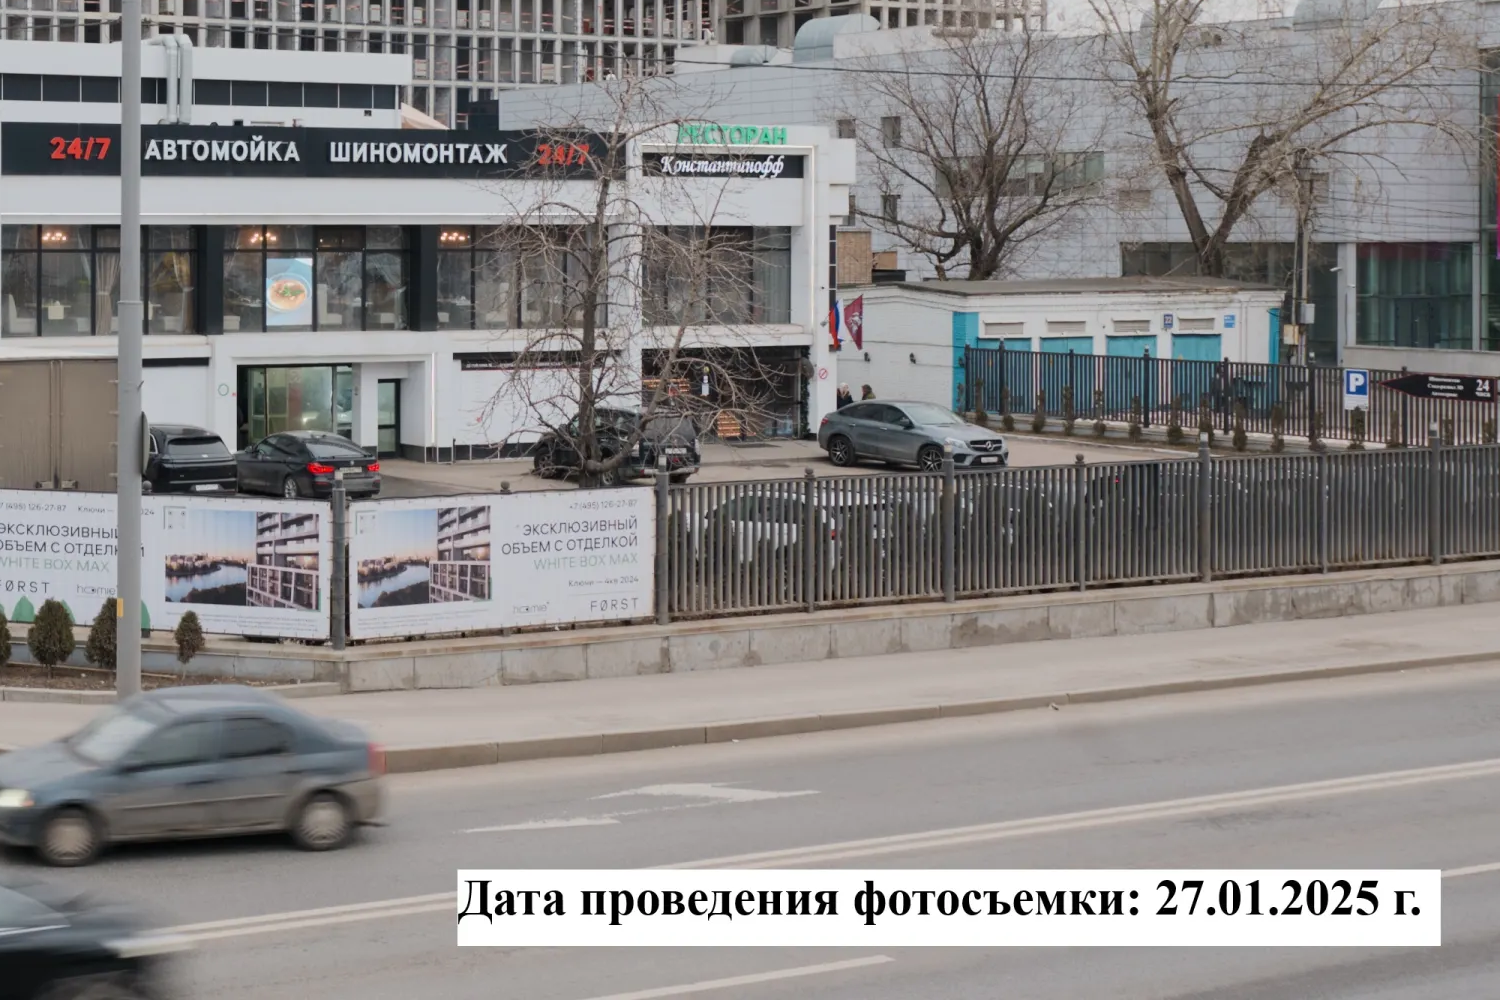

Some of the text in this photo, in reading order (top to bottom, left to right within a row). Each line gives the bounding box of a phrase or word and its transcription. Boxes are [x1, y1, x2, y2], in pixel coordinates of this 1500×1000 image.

[678, 124, 787, 145] РЕСТОРАН
[50, 135, 590, 166] 24/7 АВТОМОЙКА ШИНОМОНТАЖ 24/7
[660, 155, 784, 179] Константинофф
[1349, 373, 1365, 392] P
[1476, 379, 1490, 392] 24
[5, 503, 26, 511] (495)
[28, 504, 66, 512] 126-27-87
[78, 506, 105, 514] Ключи
[579, 502, 600, 511] (495)
[601, 499, 638, 509] 126-27-87
[523, 515, 638, 536] ЭКСКЛЮЗИВНЫЙ
[50, 542, 60, 554] С
[501, 532, 638, 555] ОБЪЕМ С ОТДЕЛКОЙ
[44, 558, 73, 571] BOX
[76, 559, 110, 573] MAX
[533, 552, 638, 570] WHITE BOX MAX
[568, 579, 594, 587] Ключи
[590, 598, 639, 612] FØRST
